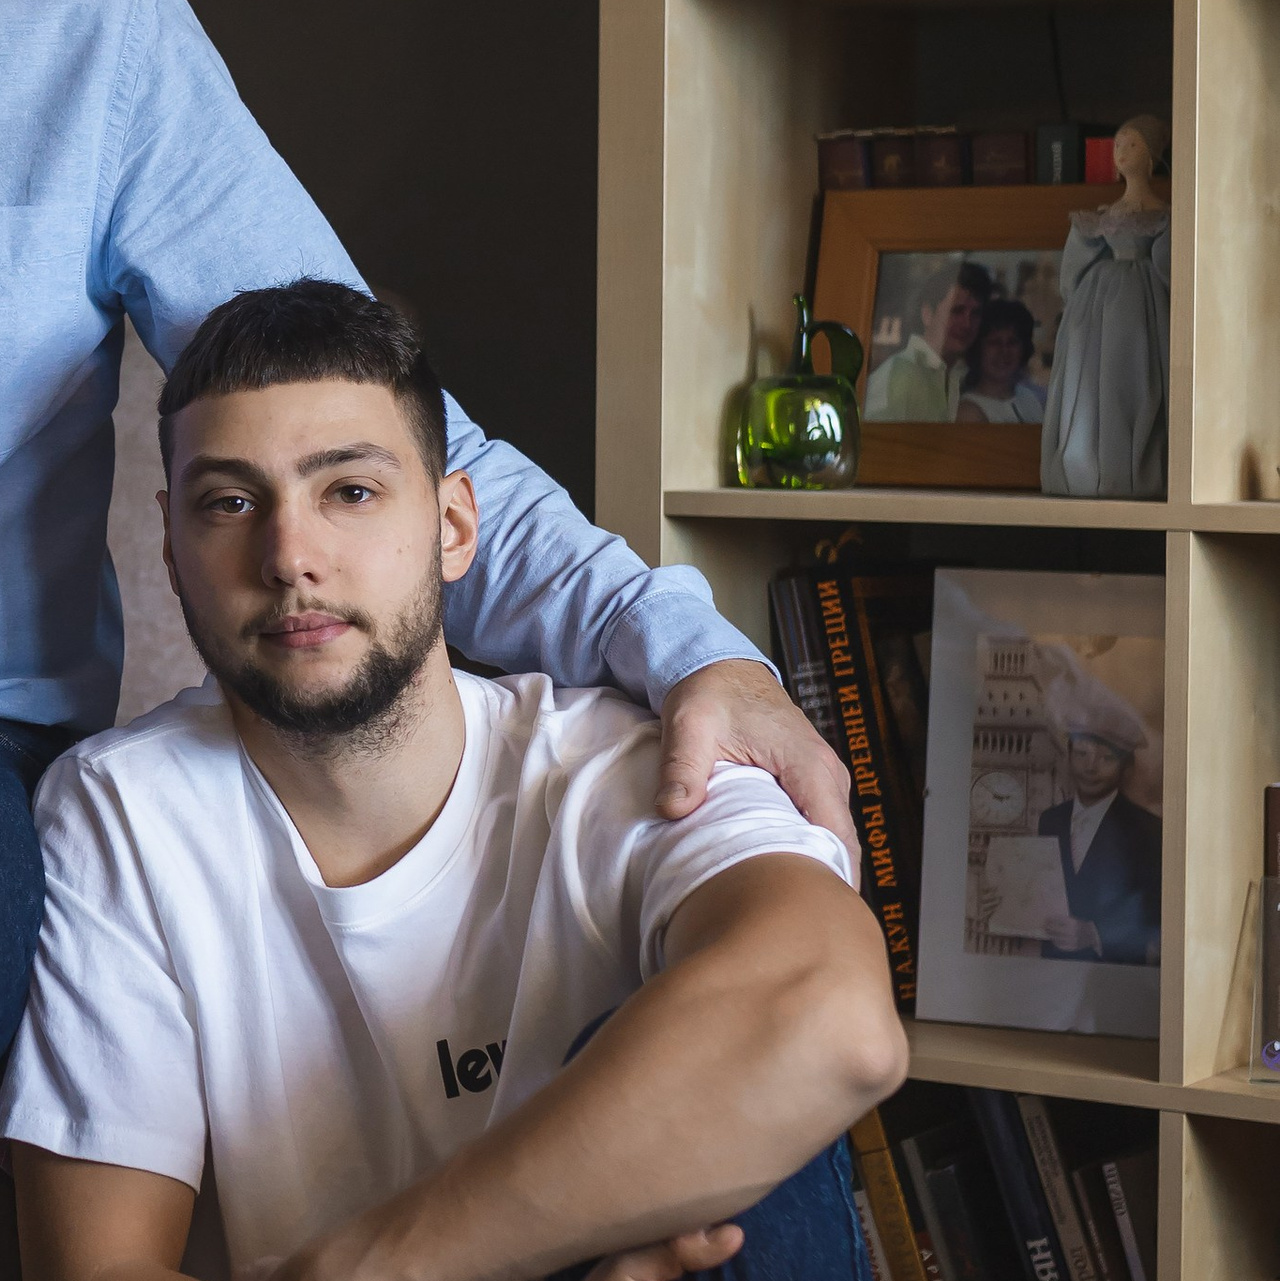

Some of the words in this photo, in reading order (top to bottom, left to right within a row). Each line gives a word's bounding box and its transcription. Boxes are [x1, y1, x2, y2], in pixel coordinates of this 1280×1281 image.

[817, 579, 855, 677] ГРЕЦИИ
[837, 682, 882, 797] ДРЕВНЕЙ
[861, 803, 898, 888] МИФЫ
